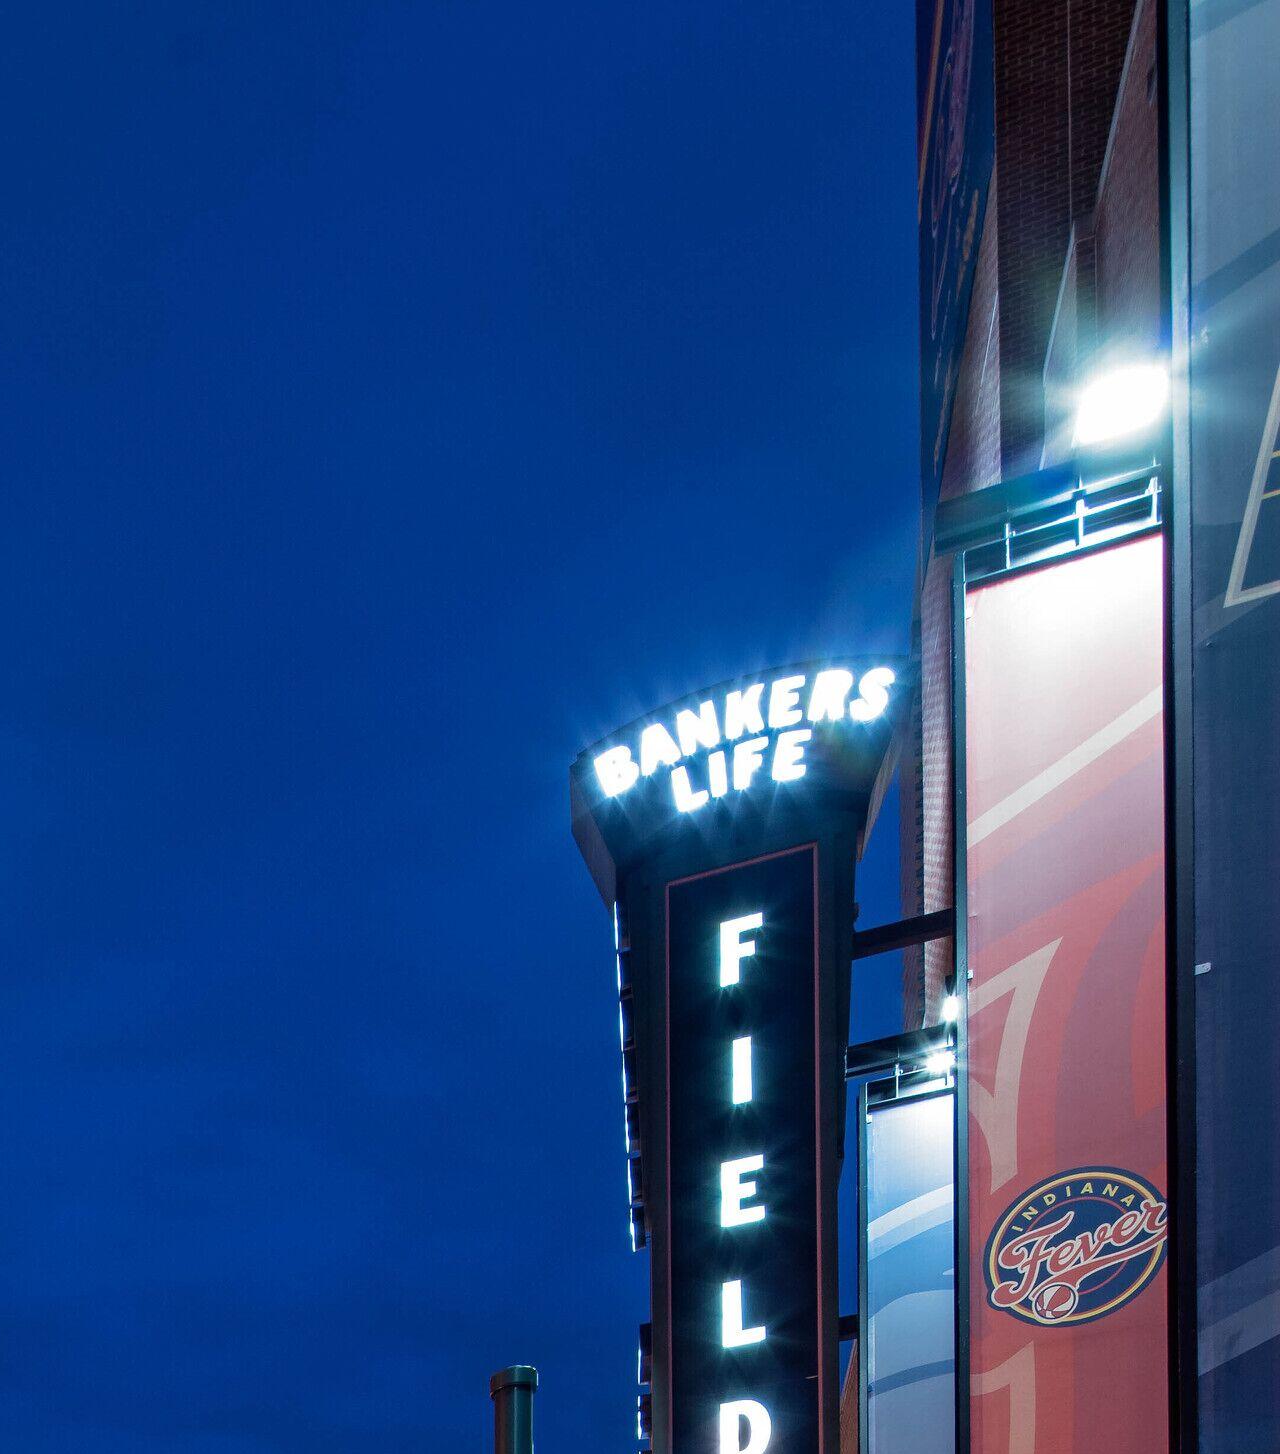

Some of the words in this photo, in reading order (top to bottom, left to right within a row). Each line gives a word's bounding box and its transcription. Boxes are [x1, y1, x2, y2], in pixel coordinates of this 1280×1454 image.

[593, 667, 896, 798] BANKERS
[670, 729, 812, 813] LIFE
[991, 1199, 1168, 1307] Fever
[1011, 1182, 1137, 1233] INDIANA
